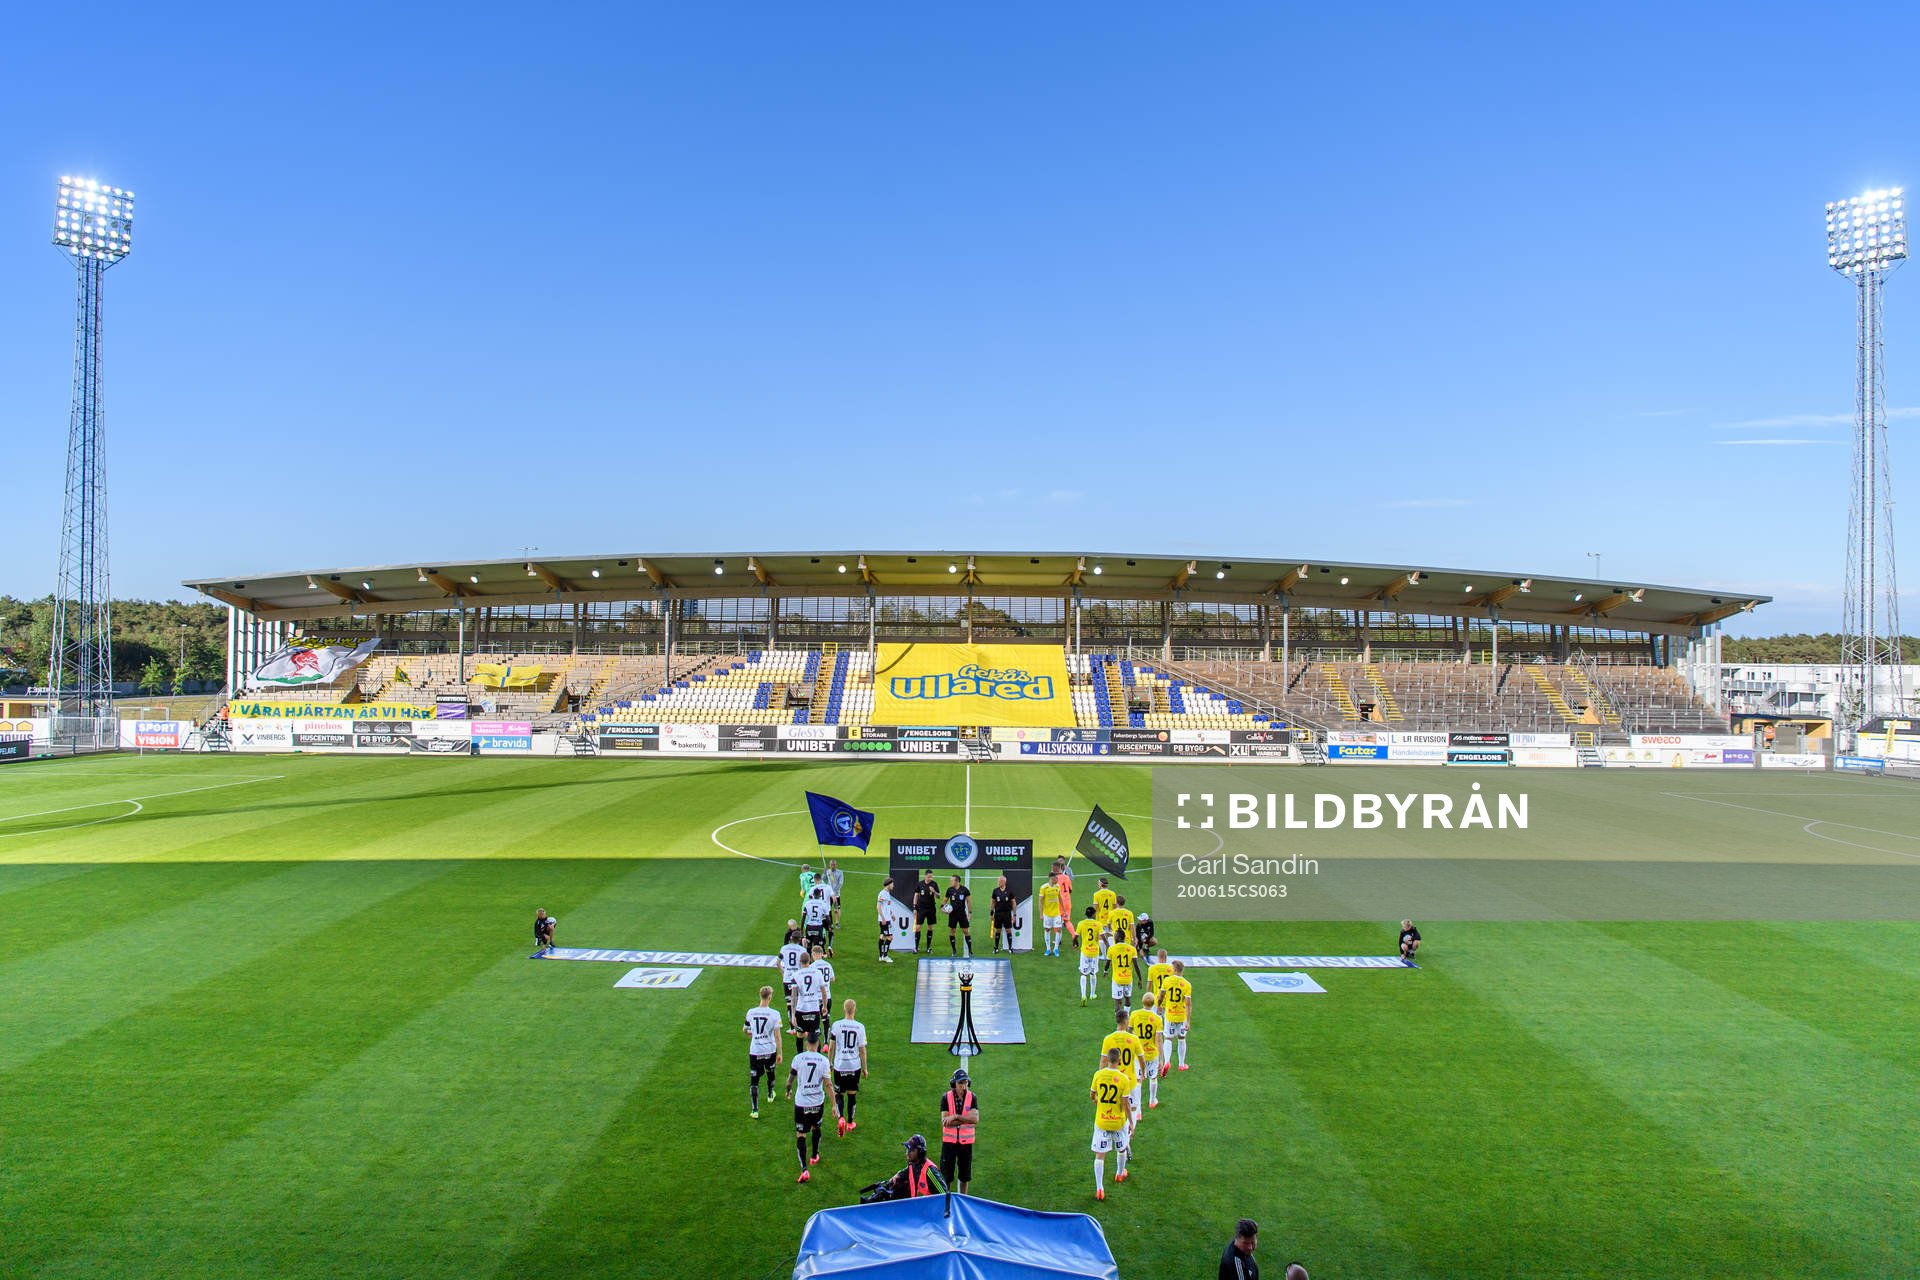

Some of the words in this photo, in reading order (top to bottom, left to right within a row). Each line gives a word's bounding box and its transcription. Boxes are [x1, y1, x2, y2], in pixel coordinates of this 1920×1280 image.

[891, 674, 1054, 700] ullared
[240, 703, 281, 717] VÅRA
[285, 703, 354, 719] HJÄRTAN
[359, 703, 378, 719] ÄR
[381, 707, 396, 718] VI
[401, 708, 431, 719] HÄR
[138, 723, 176, 733] SPORT
[304, 722, 343, 731] pinchos
[138, 736, 175, 746] VISION
[372, 735, 392, 743] BYGG
[492, 737, 528, 748] bravida
[1402, 735, 1412, 743] LR
[1414, 735, 1447, 743] REVISION
[678, 741, 706, 750] bakertilly
[786, 740, 836, 752] UNIBET
[900, 741, 950, 753] UNIBET
[1037, 743, 1094, 755] ALLSVENSKAN
[1117, 743, 1163, 751] HUSCENTRUM
[1185, 744, 1205, 752] BYGG
[897, 845, 938, 855] UNIBET
[985, 846, 1026, 856] UNIBET
[1103, 898, 1109, 910] 4
[812, 905, 819, 918] 5
[898, 917, 909, 930] U
[1116, 918, 1128, 930] 10
[1087, 928, 1094, 941] 3
[788, 951, 797, 967] 8
[1116, 953, 1130, 967] 11
[1191, 955, 1407, 967] ALLSVENSKAN
[804, 975, 812, 992] 9
[1168, 986, 1182, 1003] 13
[753, 1016, 768, 1035] 17
[1137, 1022, 1153, 1039] 18
[841, 1030, 857, 1049] 10
[807, 1062, 817, 1083] 7
[1099, 1083, 1118, 1104] 22
